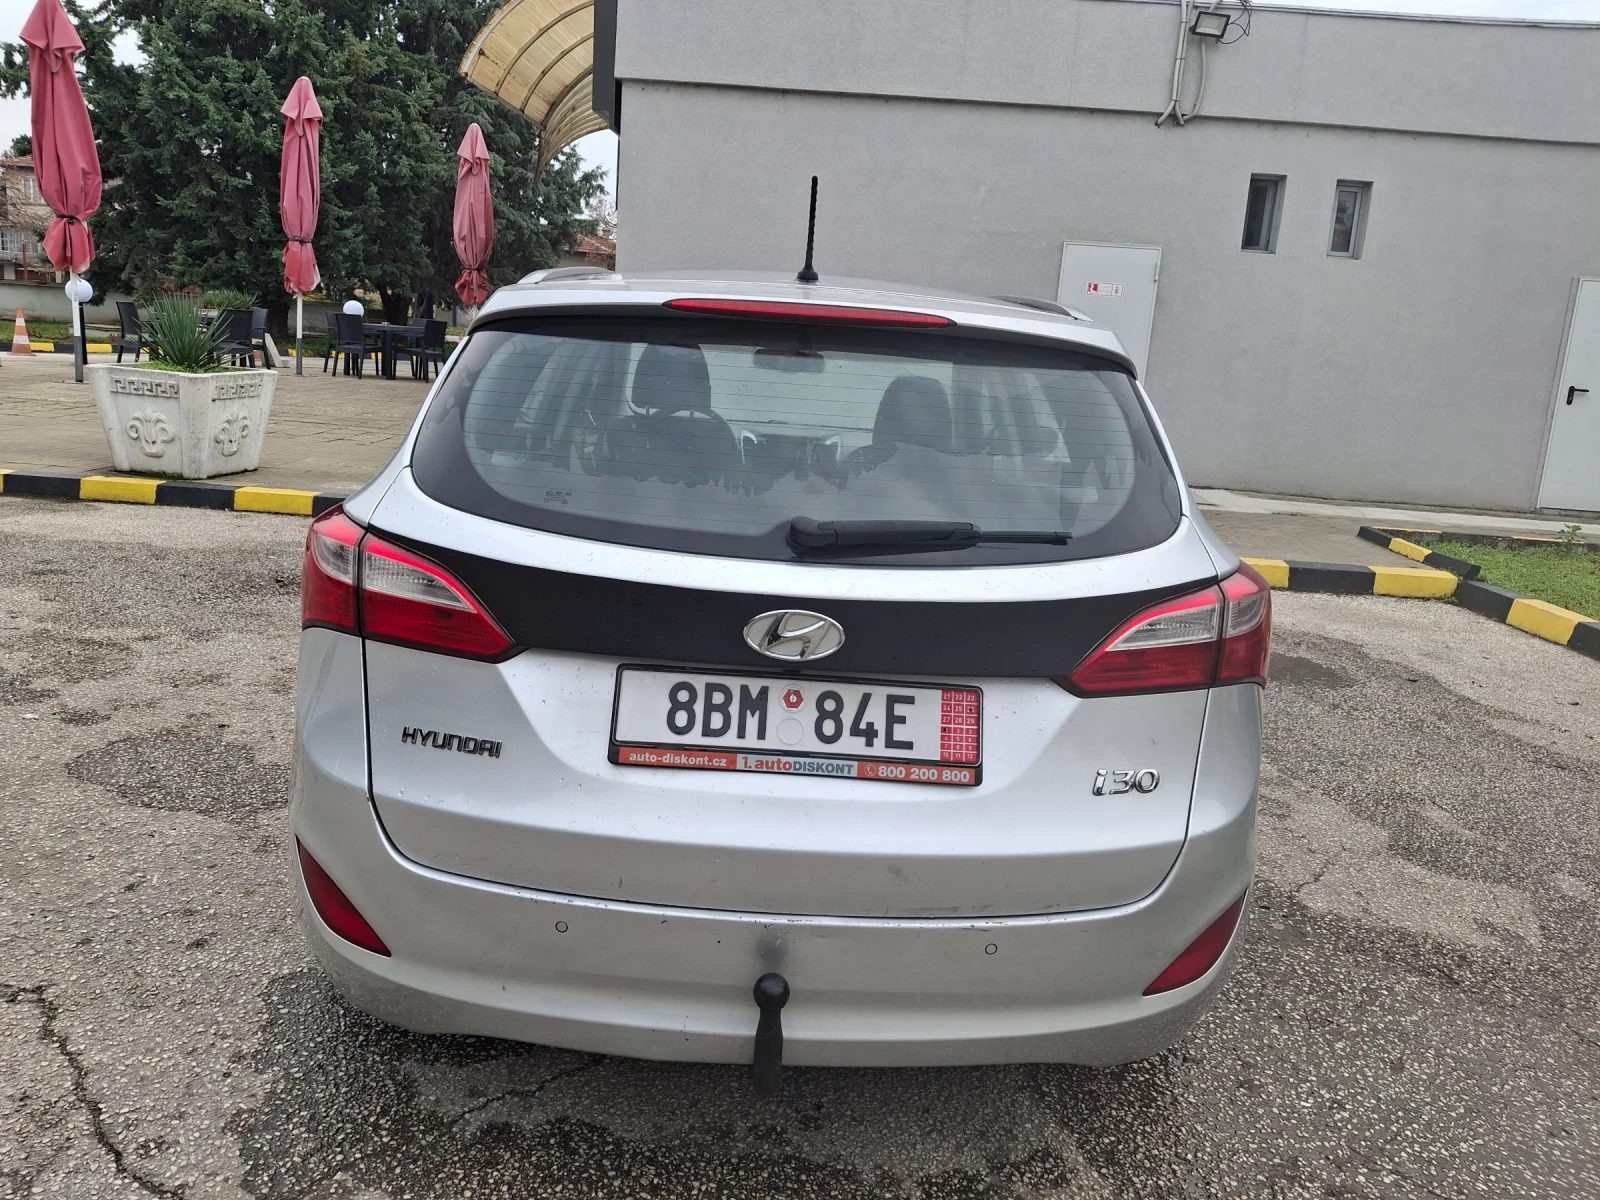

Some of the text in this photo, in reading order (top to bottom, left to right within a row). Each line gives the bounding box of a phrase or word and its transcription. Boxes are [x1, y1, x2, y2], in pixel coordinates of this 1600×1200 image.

[666, 681, 915, 750] 8BM 84E
[401, 726, 502, 759] HYUNDAI
[629, 752, 728, 768] auto-diskont.cz
[741, 756, 754, 770] 1.
[877, 766, 970, 783] 800 200 800
[1092, 768, 1160, 797] i30
